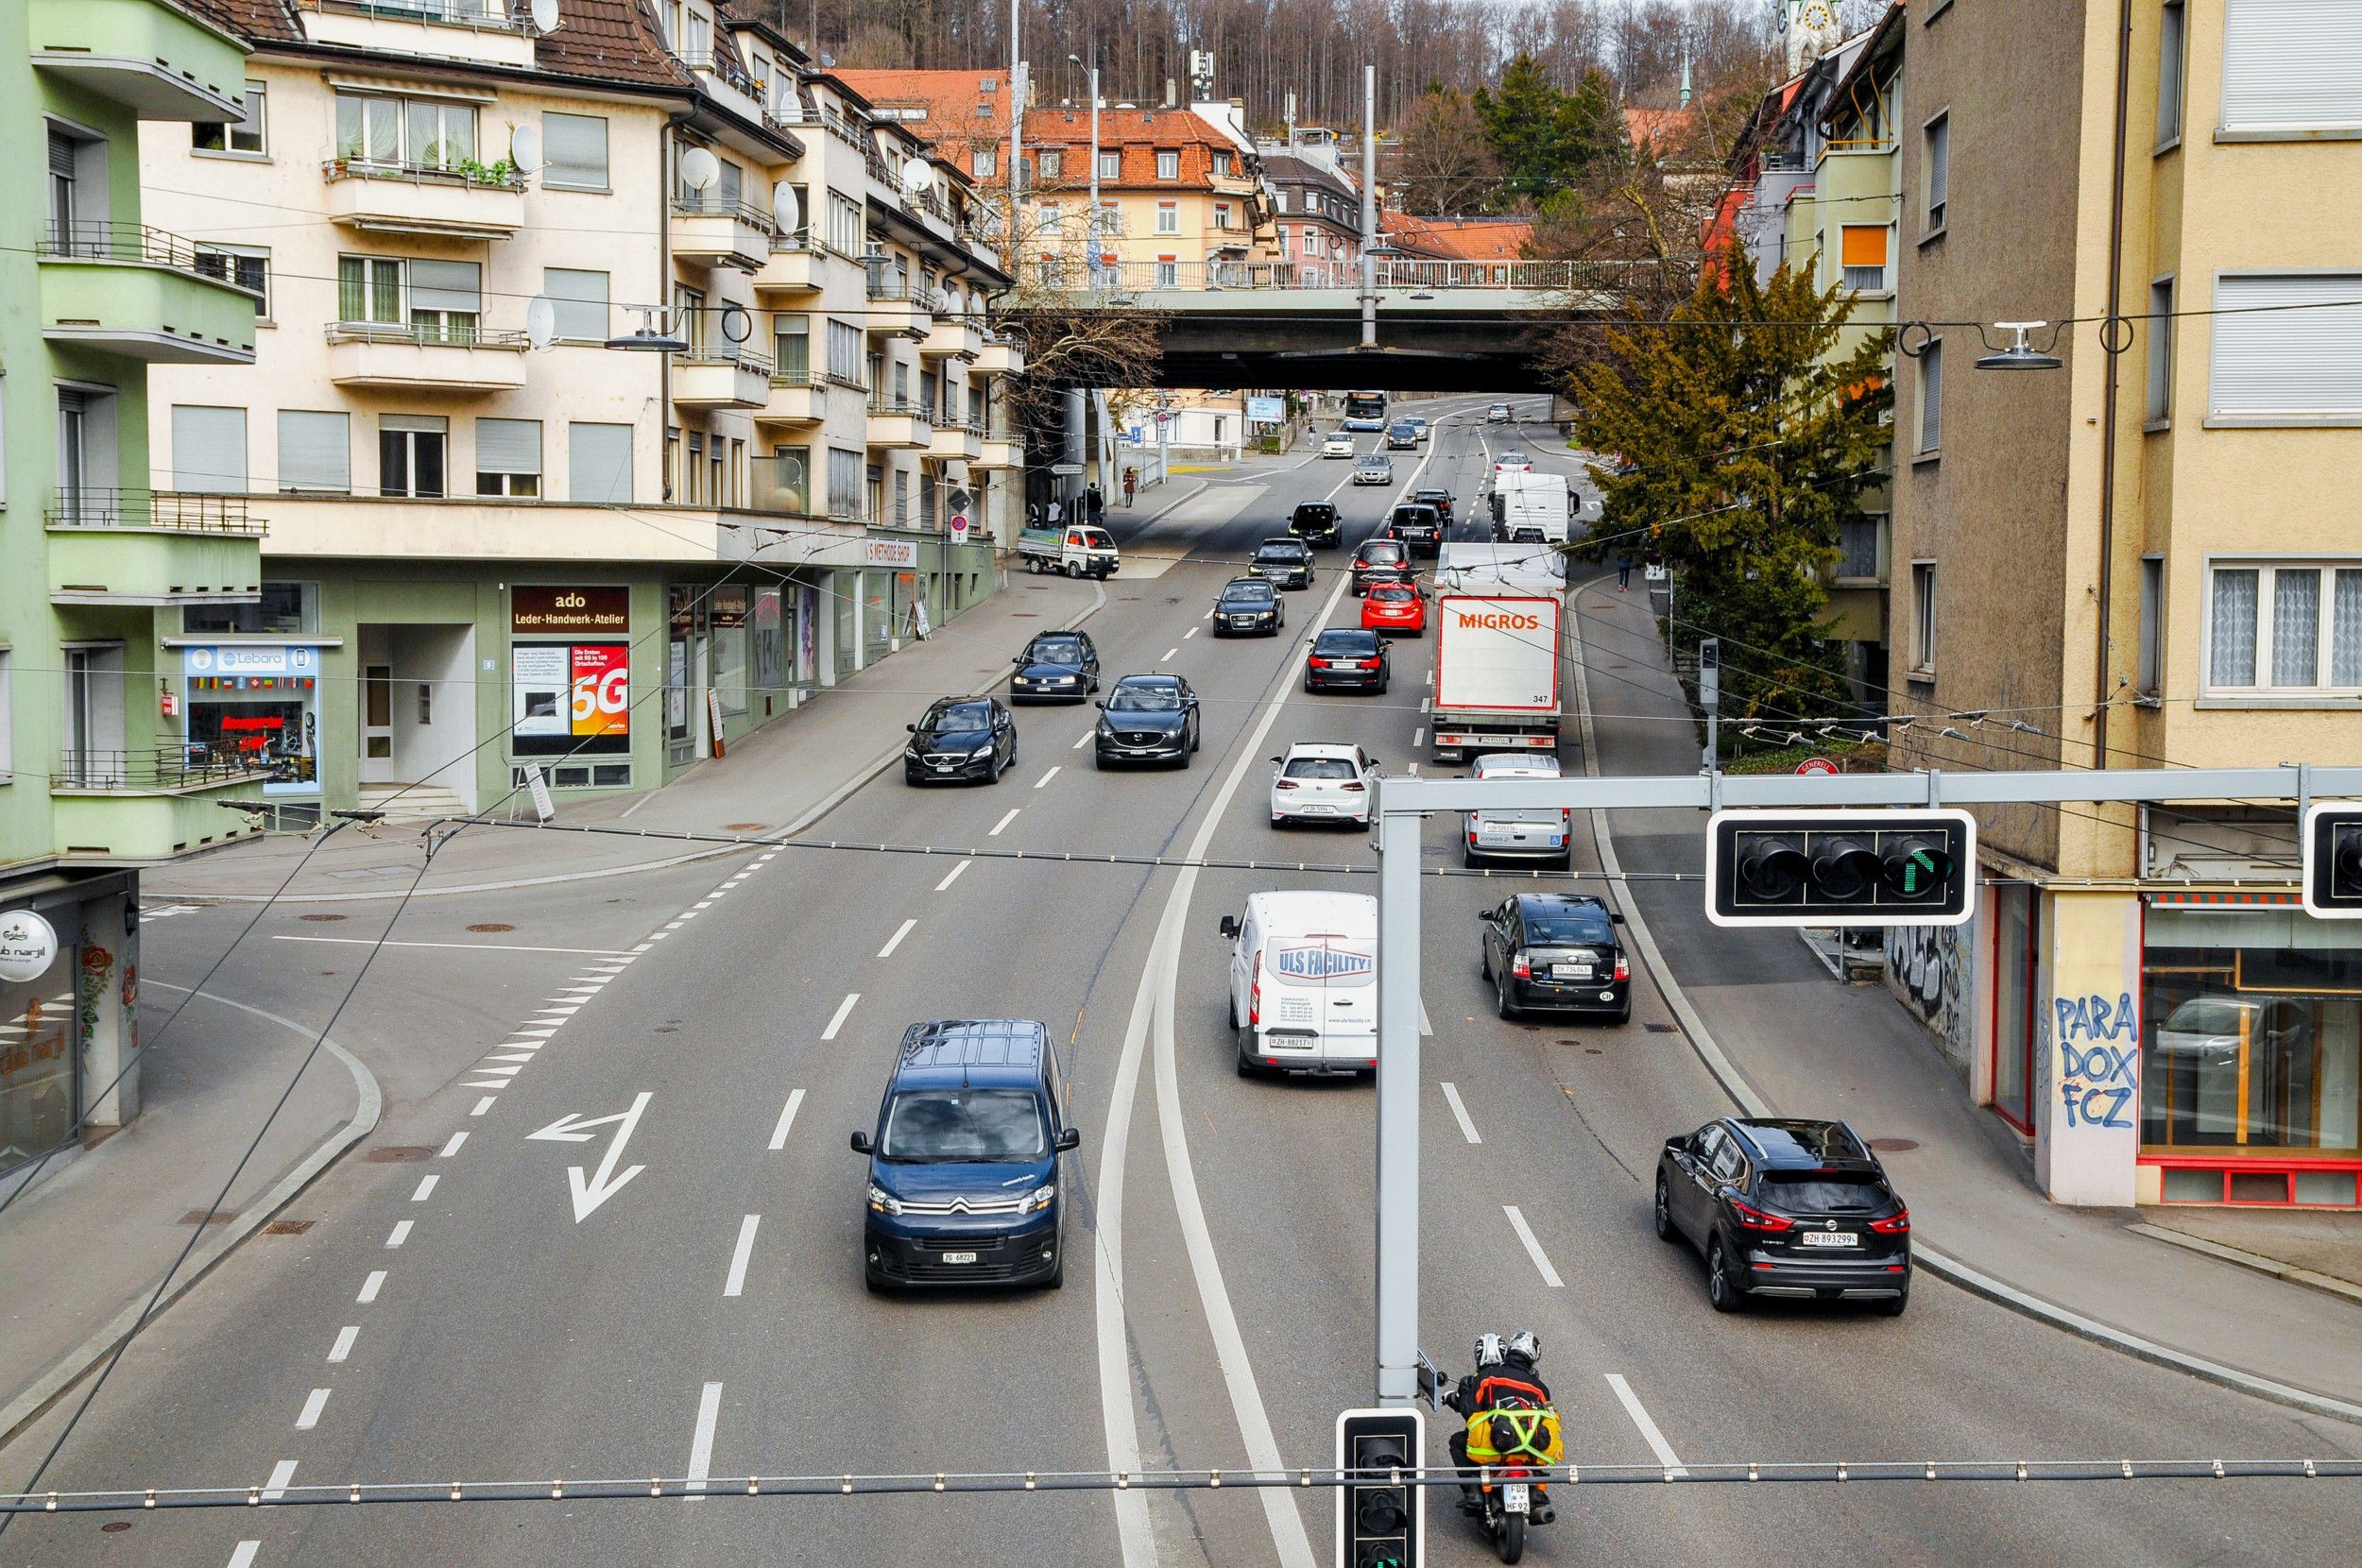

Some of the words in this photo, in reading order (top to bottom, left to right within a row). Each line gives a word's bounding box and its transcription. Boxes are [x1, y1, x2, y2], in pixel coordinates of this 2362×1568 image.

[874, 543, 897, 561] METHODE
[898, 545, 910, 562] SHOP
[556, 592, 586, 607] ado
[515, 613, 625, 624] Leder-Handwerk-Atelier
[1459, 613, 1539, 630] MIGROS
[238, 653, 282, 664] Lebara
[572, 668, 627, 722] 5G
[1801, 760, 1829, 772] GENERELL
[1279, 951, 1305, 974] ULS
[1308, 950, 1366, 975] FACILITY
[1601, 992, 1612, 1000] CH
[2055, 993, 2138, 1043] PARA
[2061, 1041, 2138, 1089] DOX
[2062, 1083, 2133, 1129] FCZ
